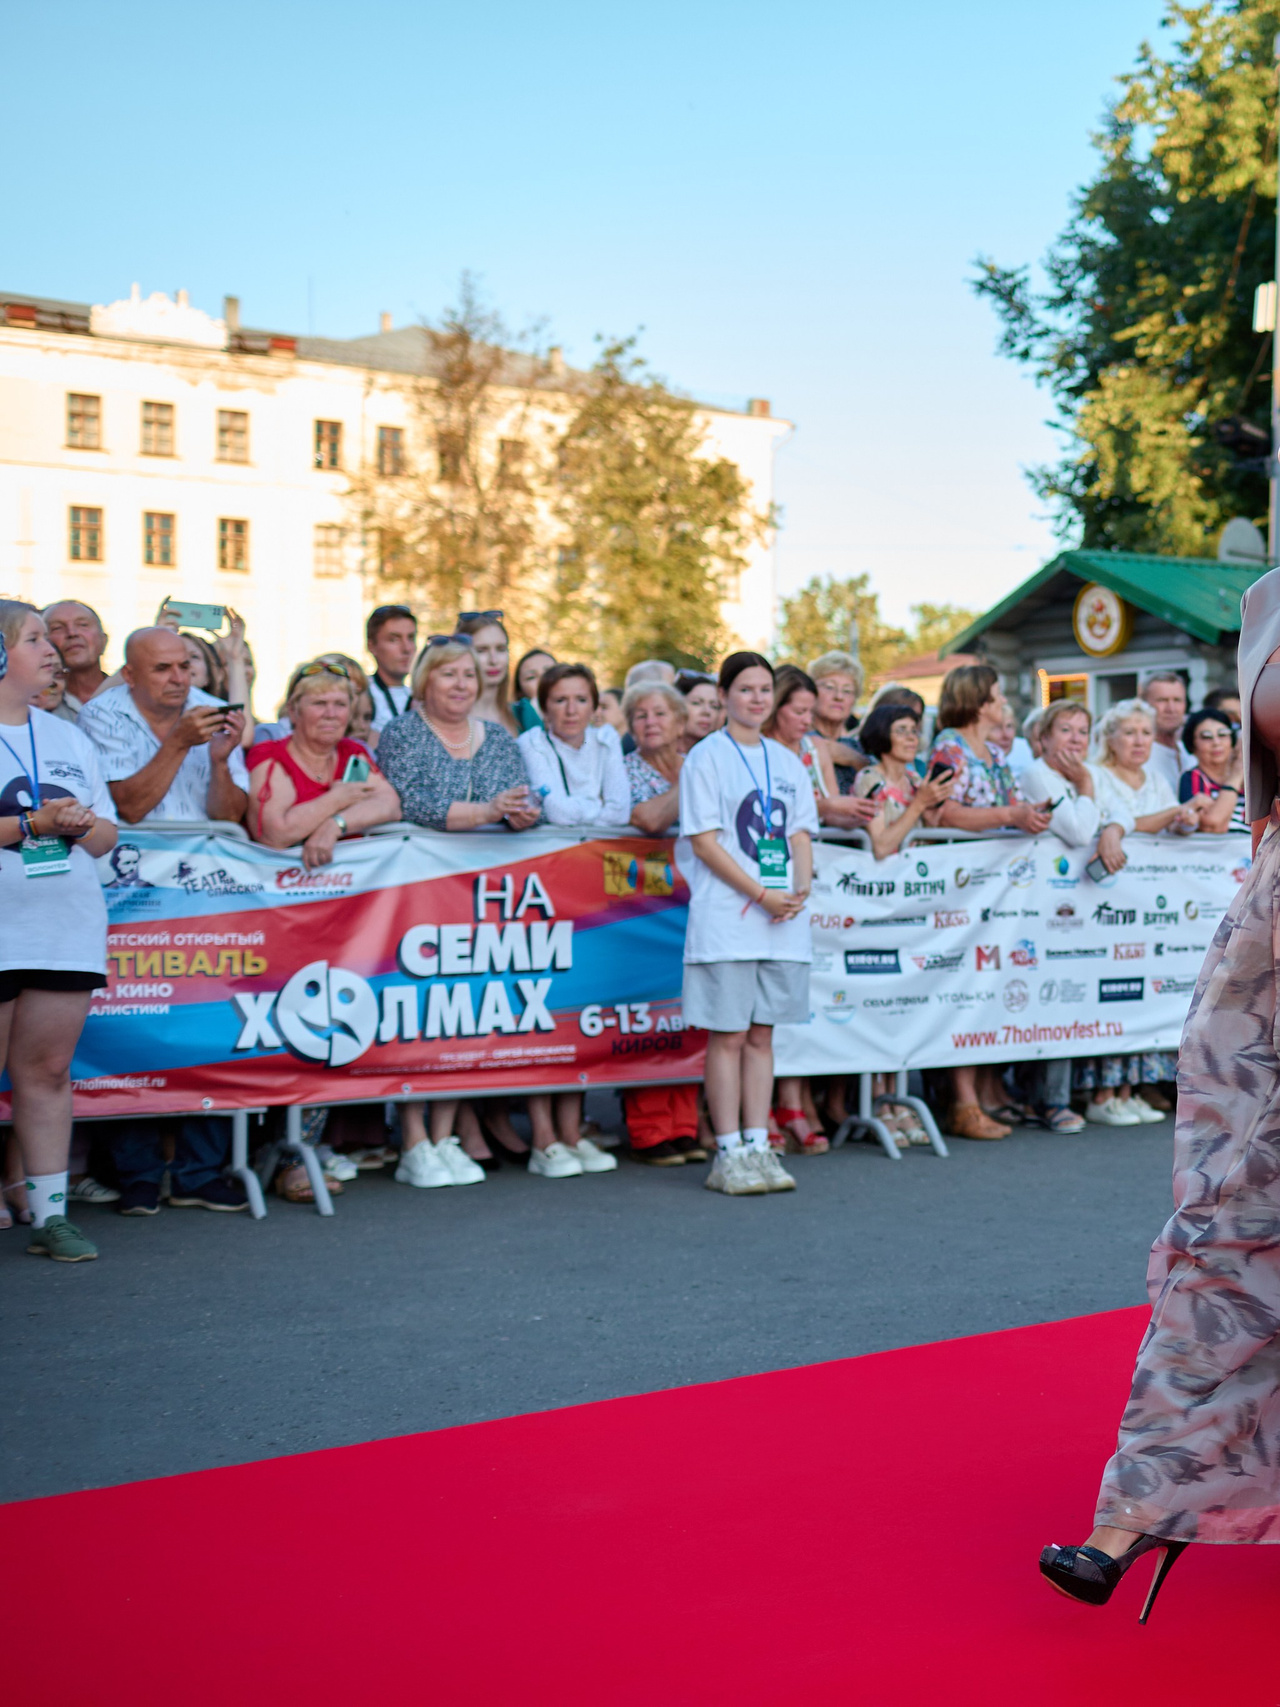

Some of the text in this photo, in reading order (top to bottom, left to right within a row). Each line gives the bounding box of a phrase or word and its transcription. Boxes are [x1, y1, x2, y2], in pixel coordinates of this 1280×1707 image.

[181, 868, 227, 896] ТЕАТР
[475, 872, 555, 921] НА
[106, 931, 265, 946] ЯТСКИЙ ОТКРЫТЫЙ
[399, 920, 574, 977] СЕМИ
[107, 949, 268, 979] ТИВАЛЬ
[116, 983, 174, 999] КИНО
[88, 1003, 170, 1016] АЛИСТИКИ
[580, 1003, 653, 1037] 6-13
[612, 1035, 683, 1055] КИРОВ
[952, 1020, 1124, 1048] www.7holmovfest.ru
